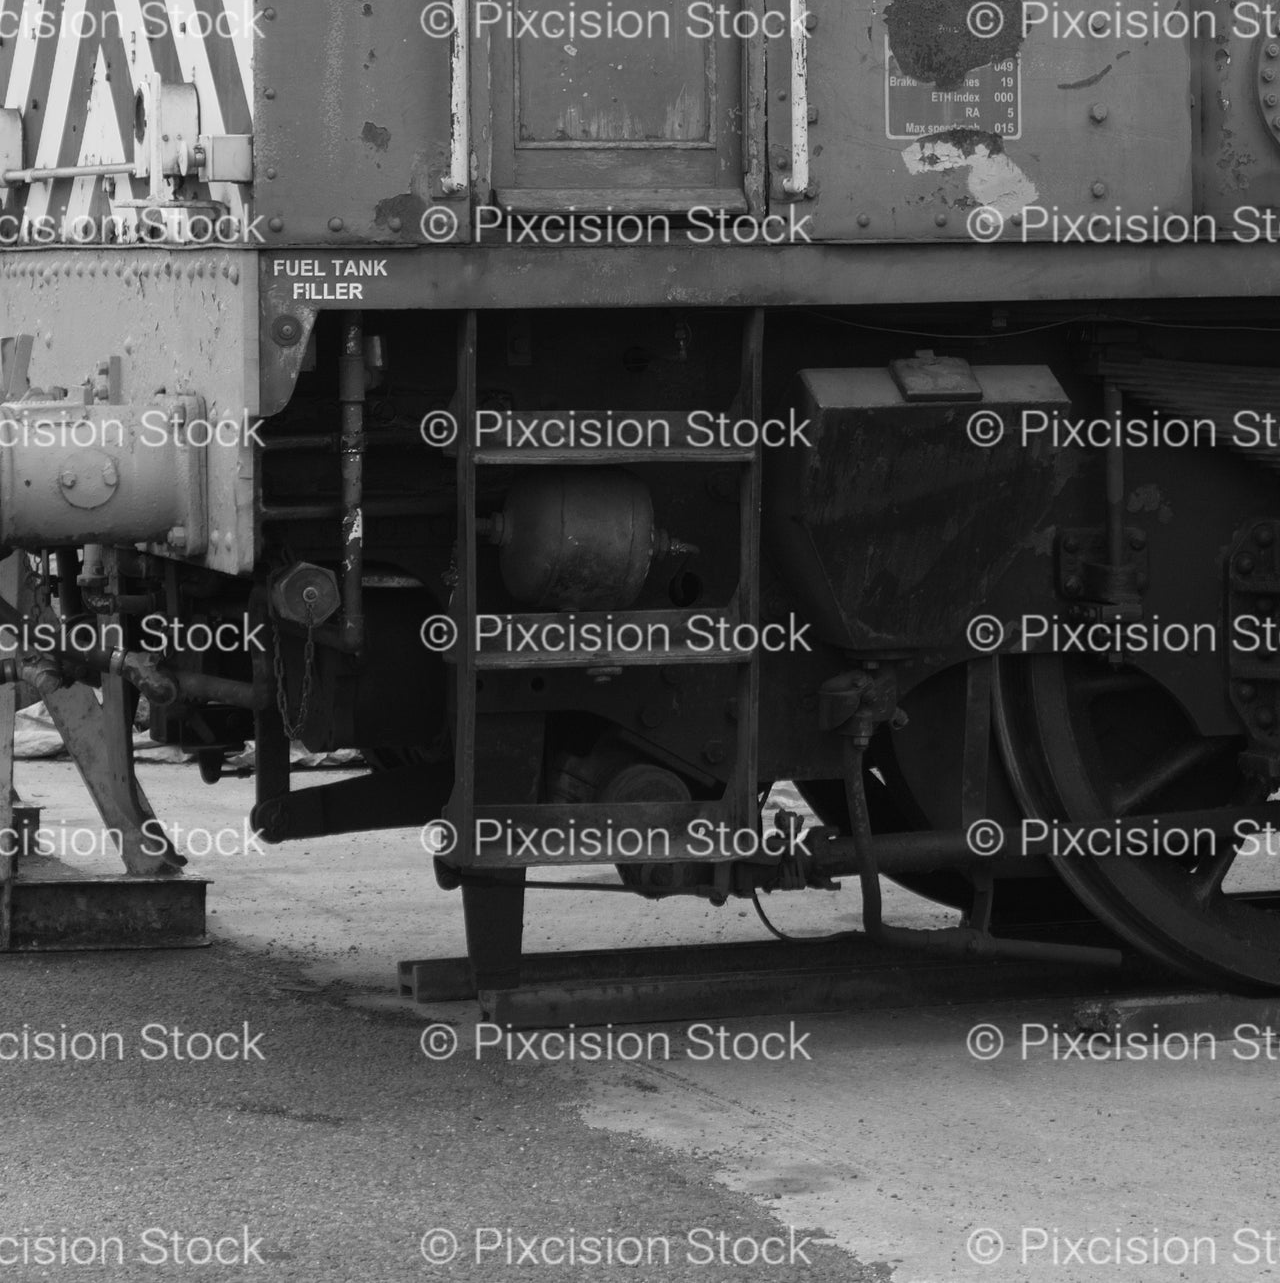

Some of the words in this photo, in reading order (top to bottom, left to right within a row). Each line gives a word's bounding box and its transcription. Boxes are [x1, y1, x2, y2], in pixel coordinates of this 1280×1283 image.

[1001, 77, 1014, 87] 19
[931, 92, 952, 103] ETH
[954, 92, 980, 103] index
[994, 92, 1014, 103] 000
[965, 107, 980, 118] RA
[1007, 107, 1014, 118] 5
[906, 123, 925, 133] Max
[994, 123, 1014, 133] 015
[273, 259, 326, 277] FUEL
[331, 259, 388, 277] TANK
[293, 283, 364, 299] FILLER
